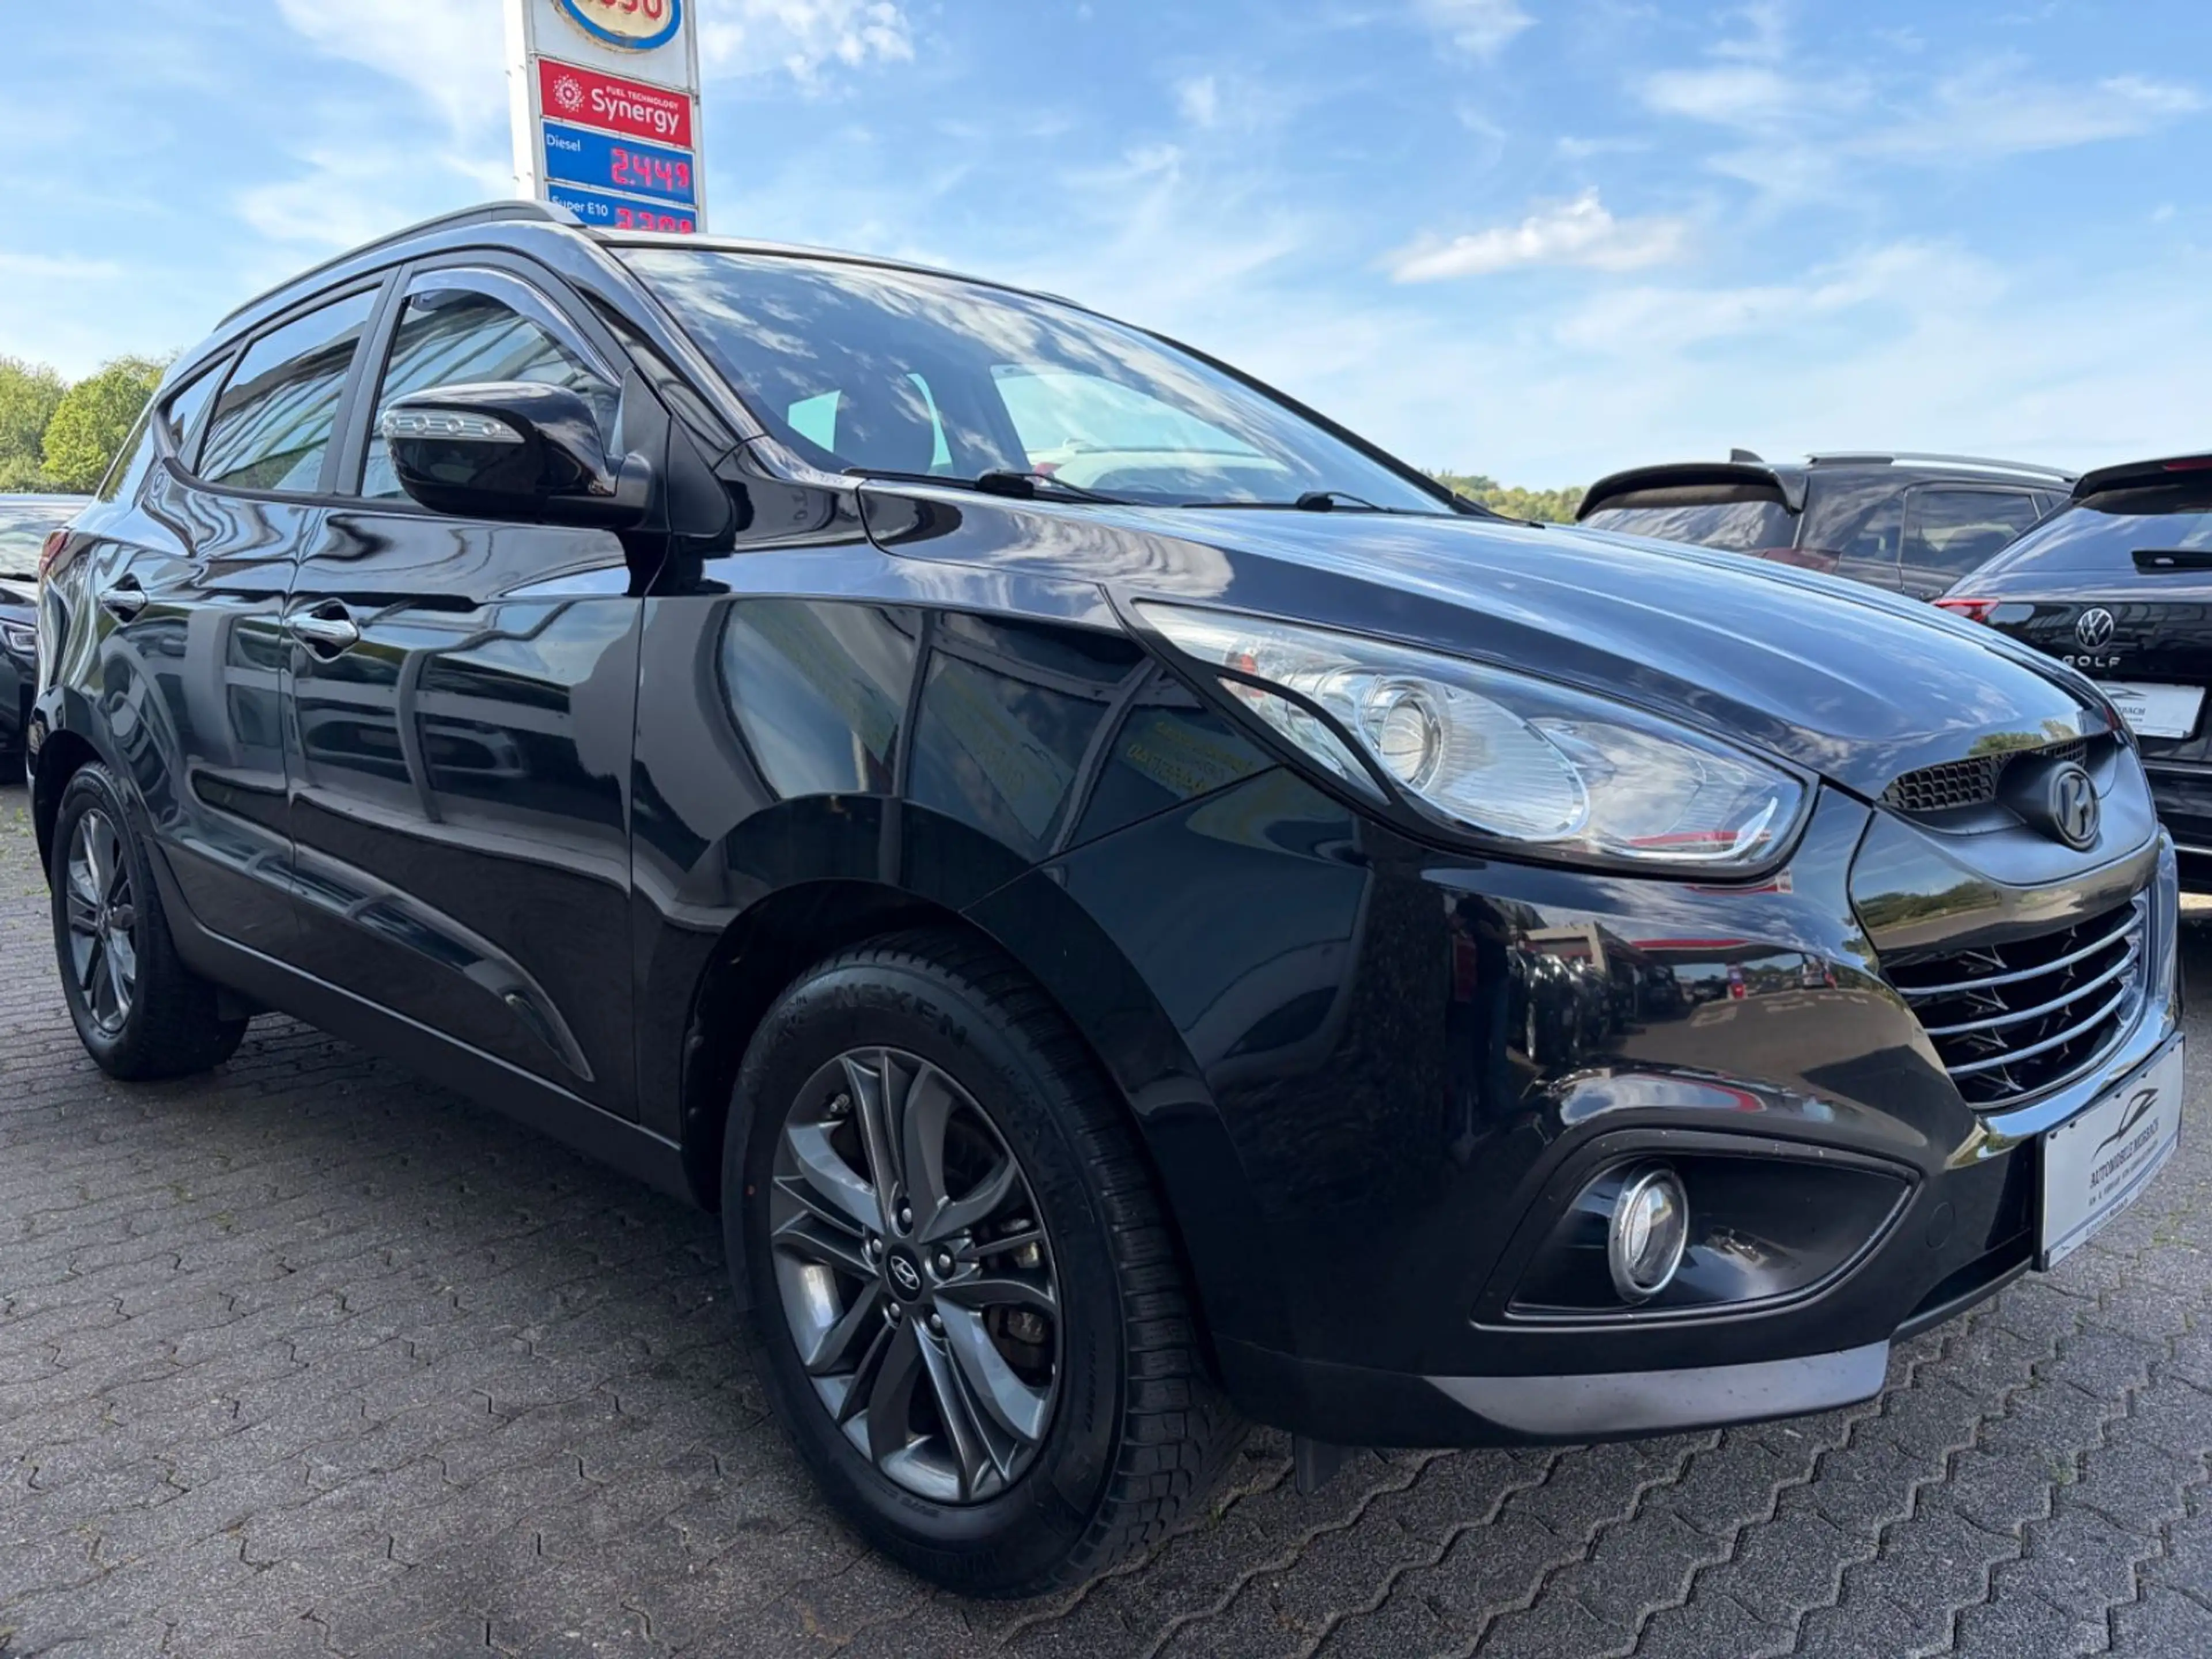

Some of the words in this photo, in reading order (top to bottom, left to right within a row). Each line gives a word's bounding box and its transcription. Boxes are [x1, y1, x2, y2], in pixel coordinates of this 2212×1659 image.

[606, 86, 626, 97] FUEL
[627, 90, 679, 111] TECHNOLOGY
[591, 88, 680, 135] Synergy
[547, 134, 581, 151] Diesel
[588, 202, 608, 217] E10
[2063, 655, 2122, 668] GOLF
[834, 983, 968, 1050] NEXEN
